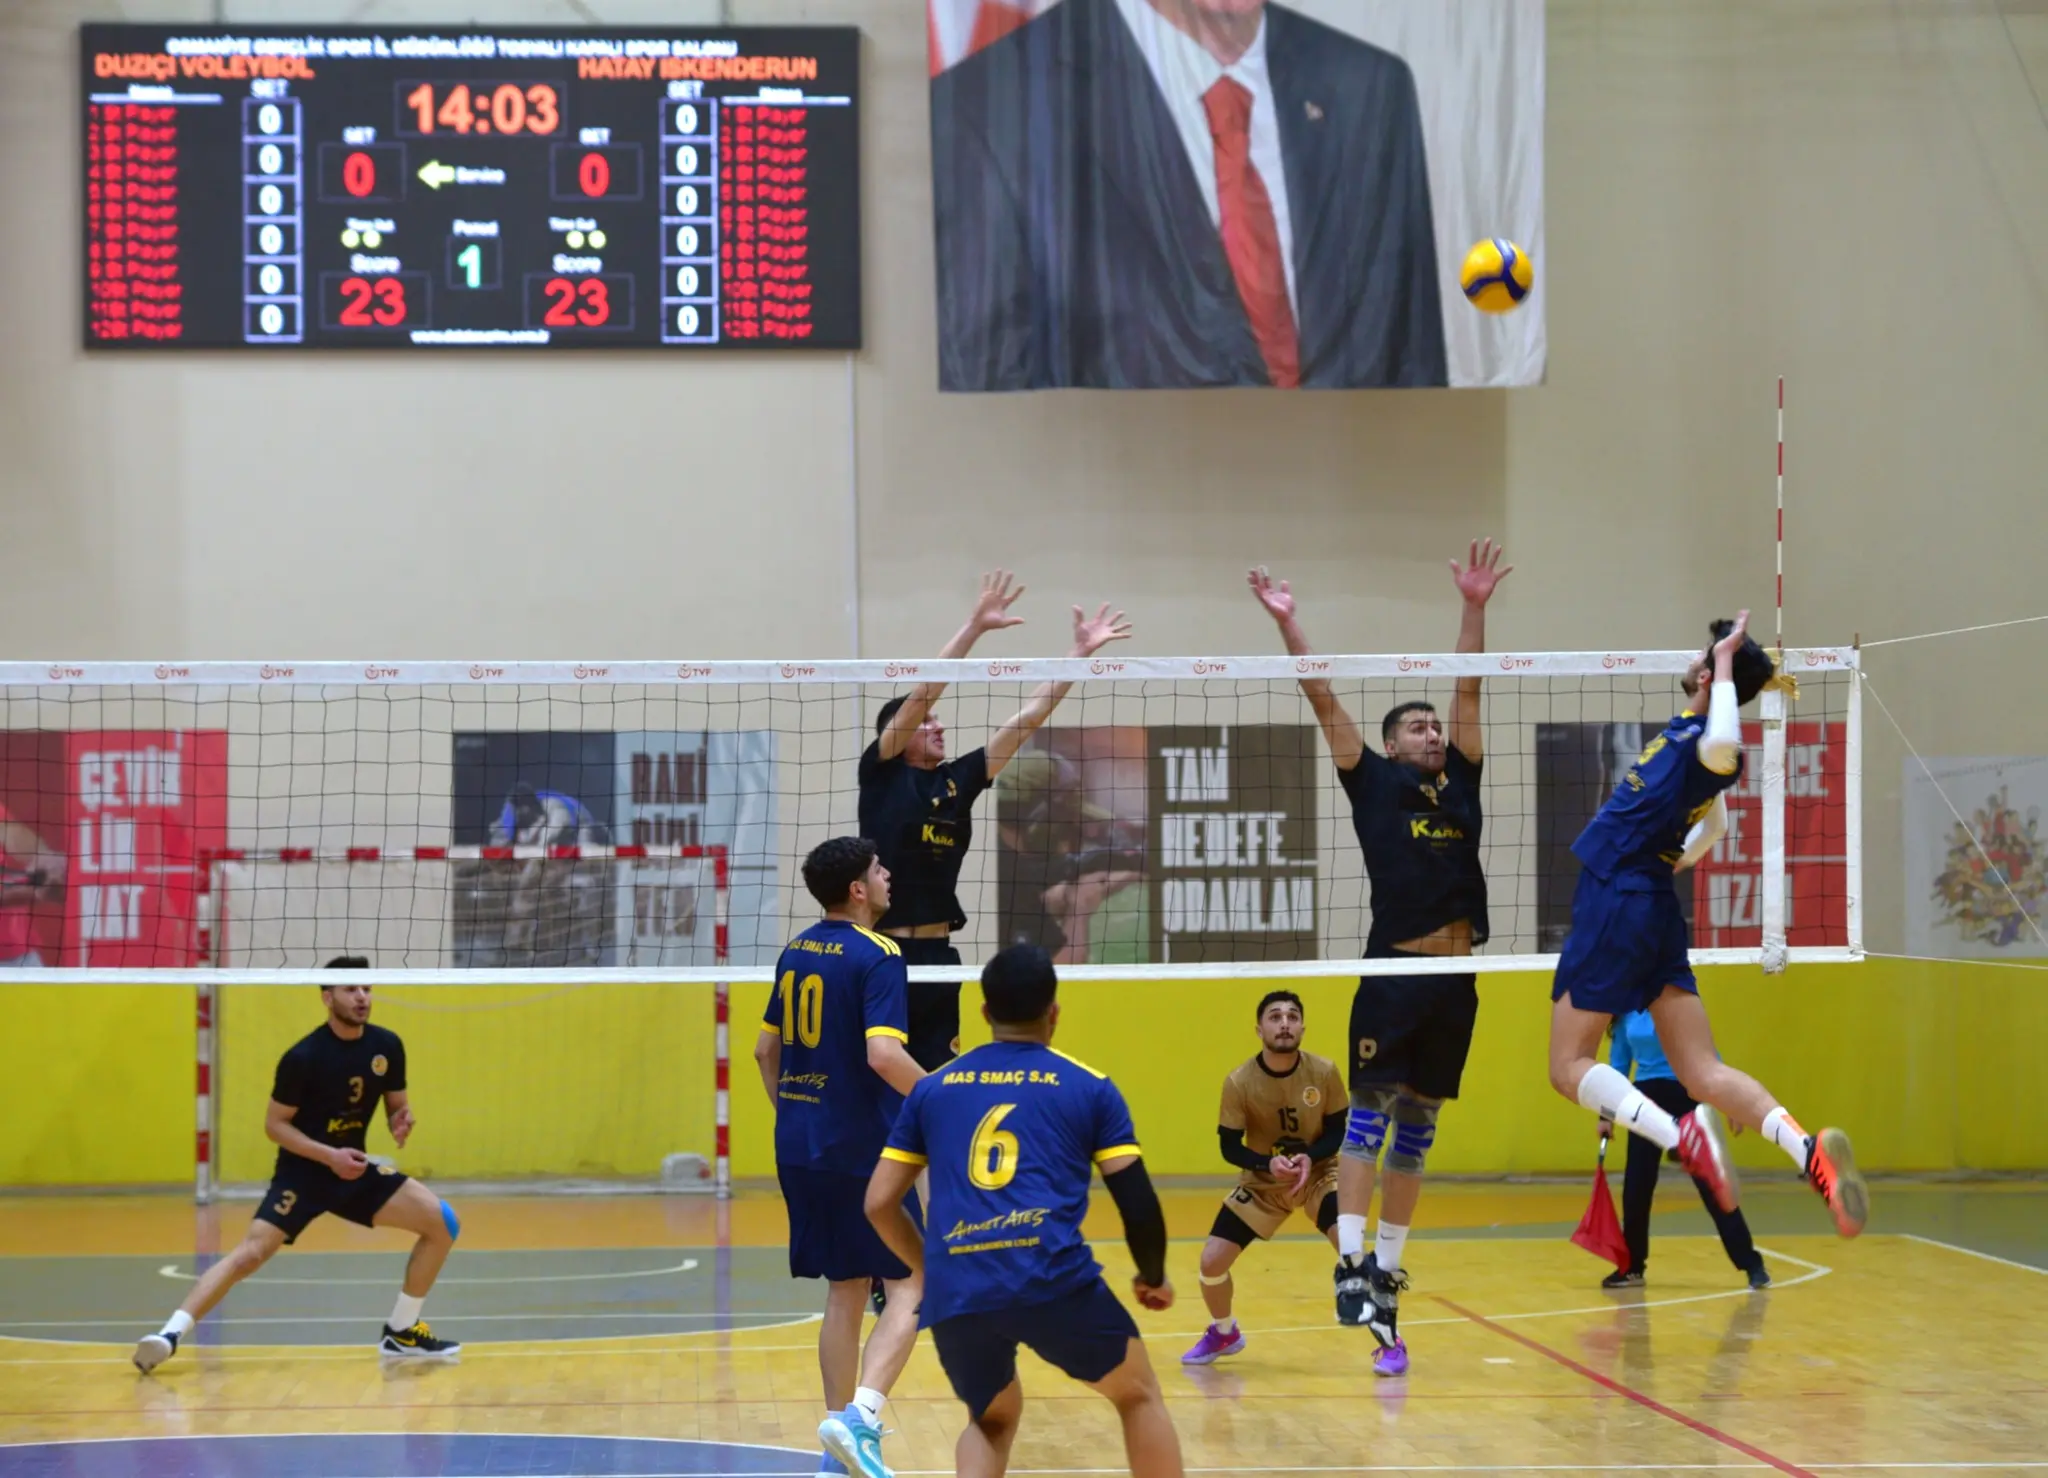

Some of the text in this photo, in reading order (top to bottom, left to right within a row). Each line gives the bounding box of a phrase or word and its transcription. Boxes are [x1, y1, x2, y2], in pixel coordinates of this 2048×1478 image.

[179, 54, 315, 79] VOLEYBOL
[578, 57, 656, 79] HATAY
[258, 104, 283, 135] 0
[408, 83, 560, 135] 14:03
[675, 104, 699, 135] 0
[258, 144, 283, 175] 0
[343, 151, 375, 198] 0
[578, 152, 610, 198] 0
[675, 144, 699, 175] 0
[258, 184, 283, 215] 0
[675, 184, 699, 215] 0
[258, 224, 283, 255] 0
[675, 224, 699, 255] 0
[258, 264, 283, 295] 0
[457, 244, 481, 289] 1
[675, 265, 699, 296] 0
[339, 277, 407, 327] 23
[543, 277, 610, 327] 23
[258, 304, 283, 335] 0
[675, 305, 699, 336] 0
[64, 668, 84, 677] TVF
[170, 668, 190, 677] TVF
[275, 668, 295, 677] TVF
[379, 668, 400, 677] TVF
[485, 668, 504, 677] TVF
[589, 667, 609, 677] TVF
[692, 667, 712, 676] TVF
[796, 666, 816, 676] TVF
[900, 665, 919, 675] TVF
[1002, 665, 1022, 674] TVF
[1105, 663, 1125, 673] TVF
[1208, 663, 1228, 673] TVF
[1311, 661, 1330, 671] TVF
[1413, 660, 1432, 670] TVF
[1515, 659, 1535, 668] TVF
[1617, 657, 1637, 667] TVF
[1819, 654, 1839, 664] TVF
[79, 744, 182, 812] ÇEVİK
[1160, 747, 1230, 802] TAM
[1161, 811, 1288, 868] HEDEFE
[1160, 876, 1314, 933] ODAKLAN
[778, 969, 824, 1049] 10
[348, 1075, 365, 1103] 3
[942, 1070, 1060, 1087] MAS SMAÇ S.K.
[1277, 1107, 1300, 1133] 15
[967, 1103, 1020, 1191] 6
[273, 1189, 298, 1217] 3
